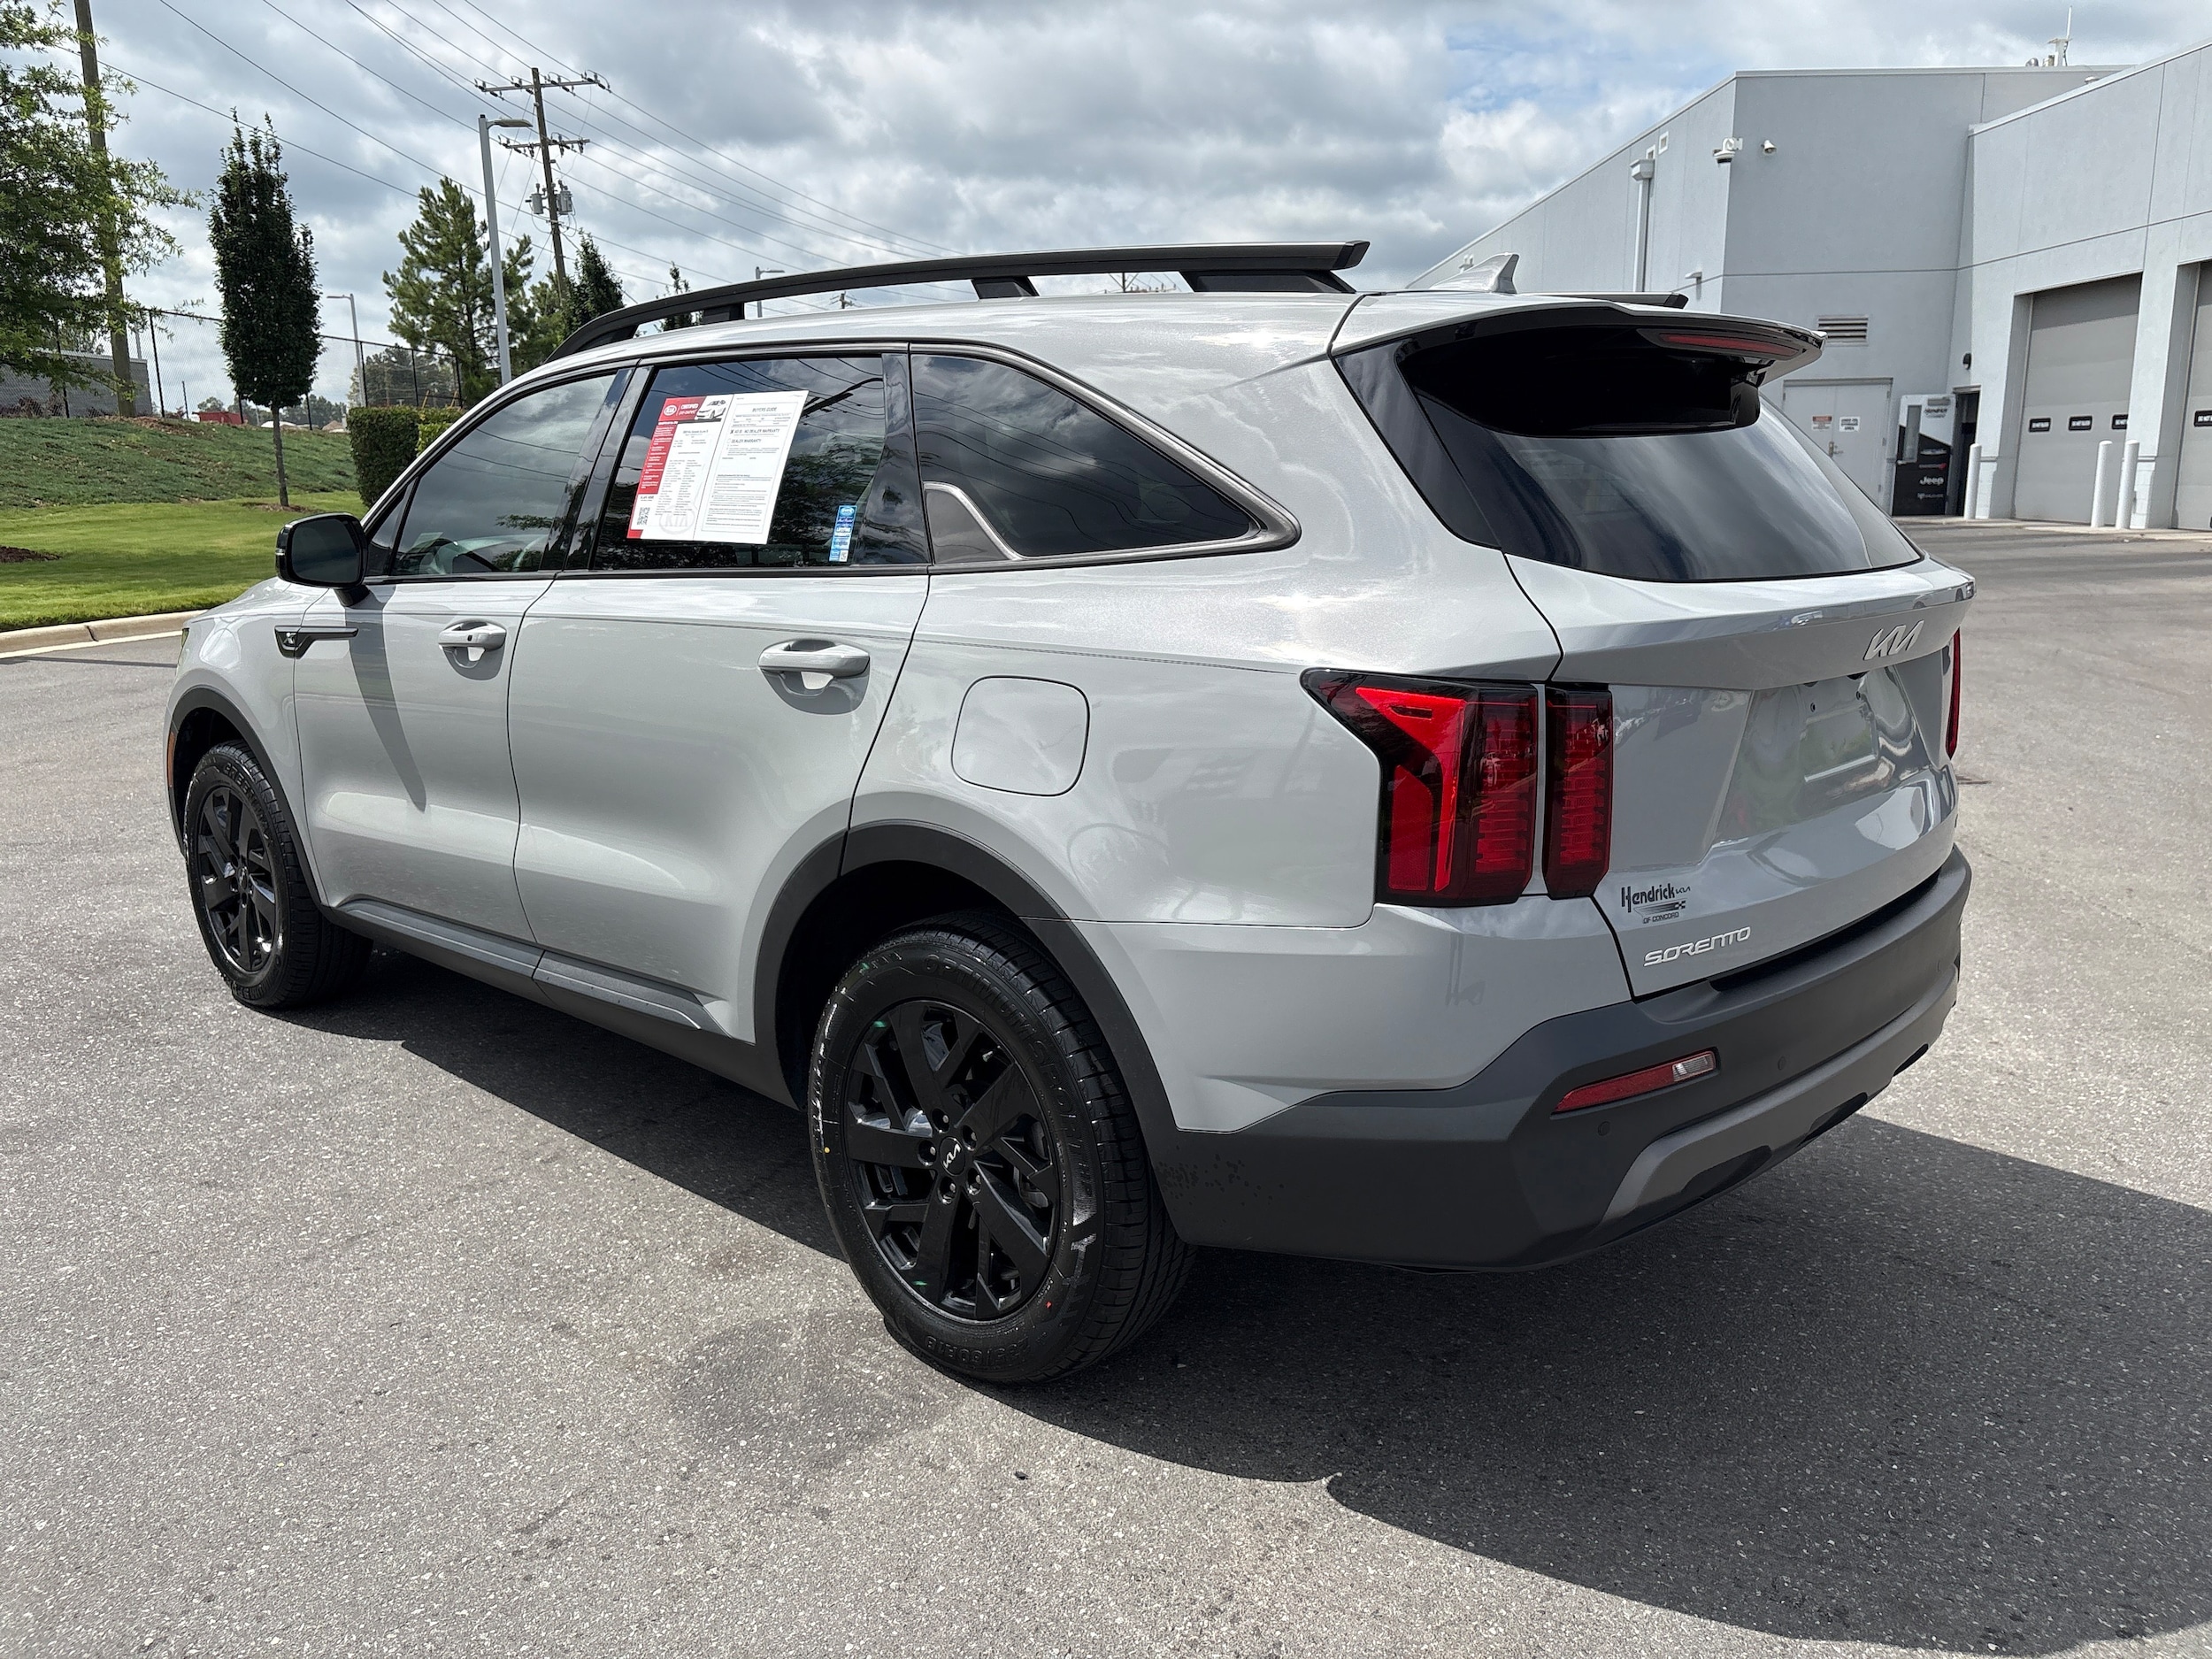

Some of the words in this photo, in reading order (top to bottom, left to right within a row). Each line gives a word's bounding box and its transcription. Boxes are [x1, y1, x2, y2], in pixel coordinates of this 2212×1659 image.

[1919, 476, 1944, 486] Jeep
[665, 514, 687, 527] KIA
[1863, 619, 1924, 661] KIA
[1621, 883, 1676, 913] Hendrick
[1642, 916, 1652, 925] OF
[1652, 911, 1680, 923] CONCORD
[1643, 926, 1752, 968] SORENTO
[942, 1143, 962, 1169] KIA
